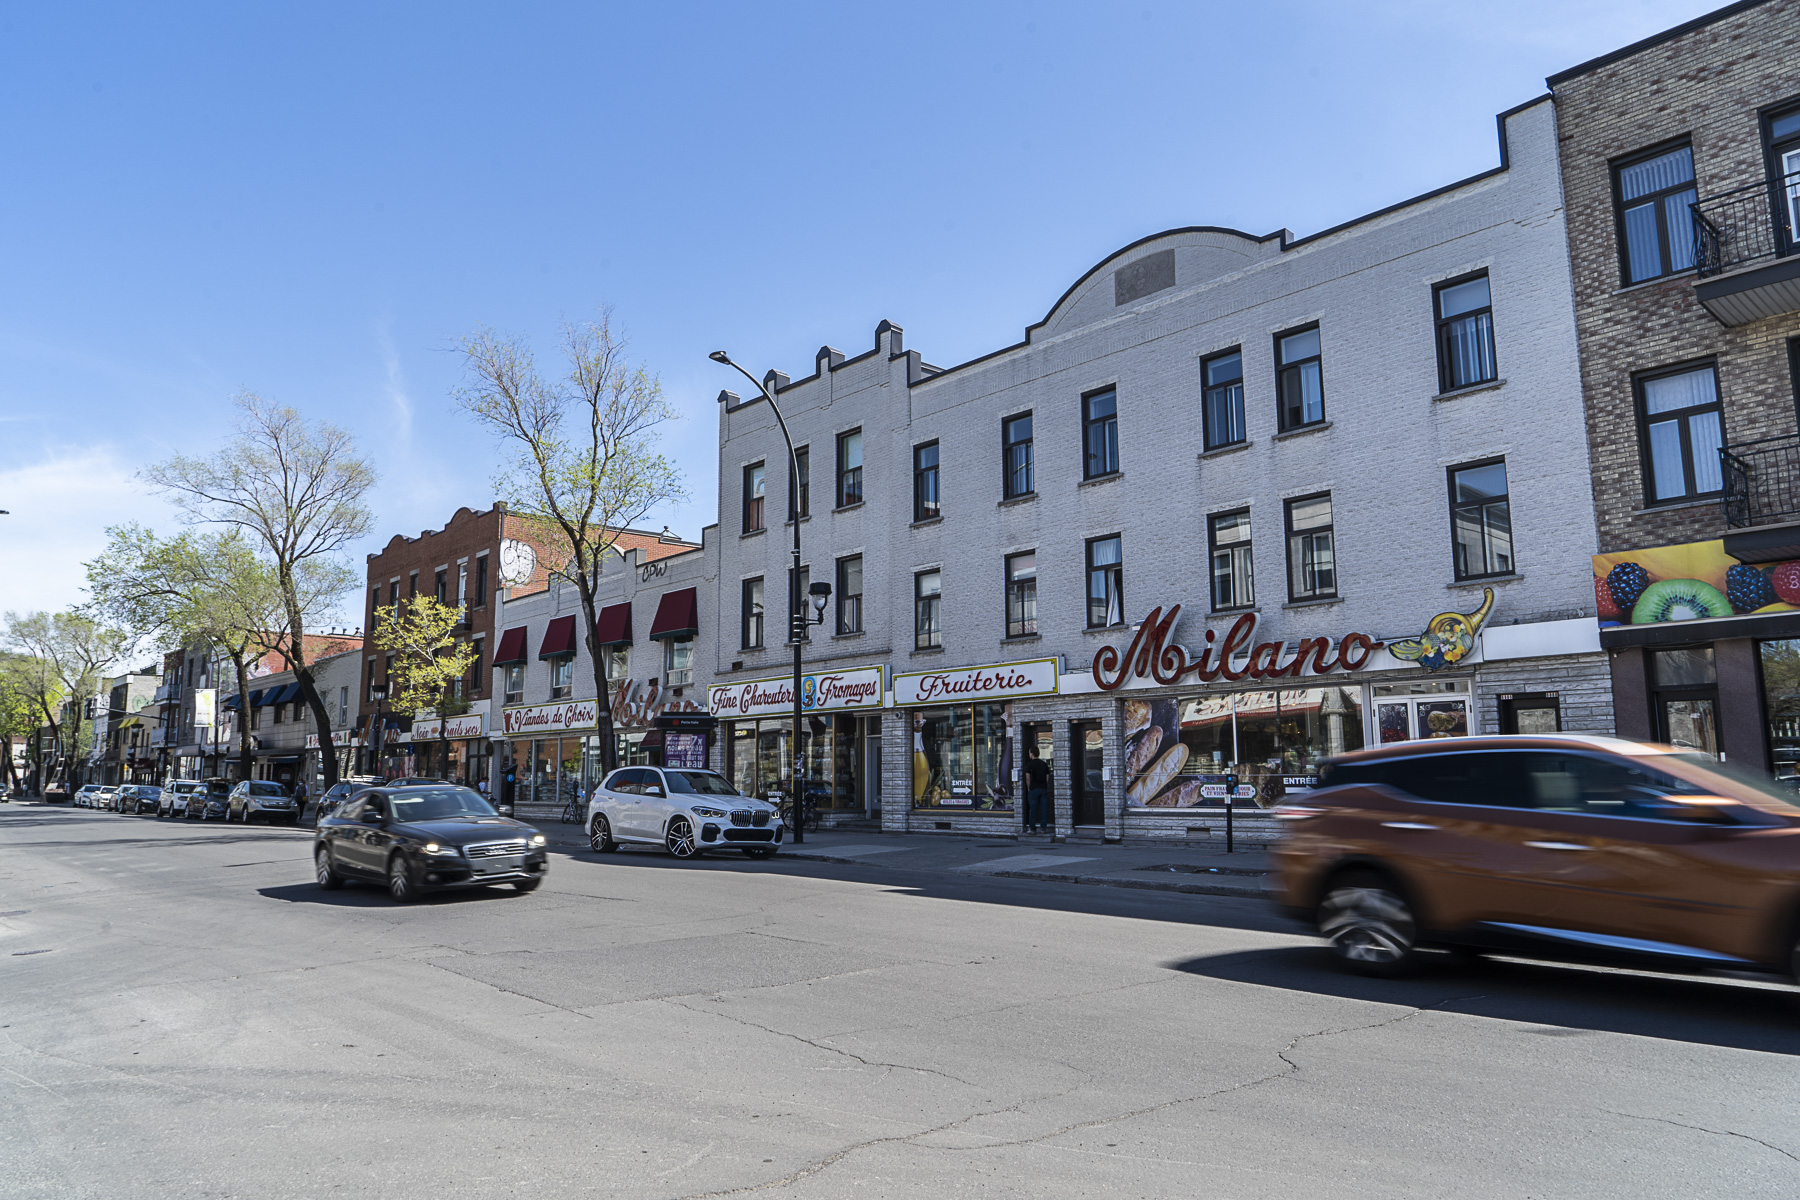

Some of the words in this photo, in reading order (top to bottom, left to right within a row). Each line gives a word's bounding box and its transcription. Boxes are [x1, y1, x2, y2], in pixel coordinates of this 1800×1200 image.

[1092, 604, 1388, 691] Milano
[711, 686, 737, 715] Fine
[739, 683, 795, 714] Charcuteri
[817, 675, 877, 706] Fromages
[916, 669, 1032, 701] Fruiterie
[514, 708, 550, 732] Viandes
[551, 707, 563, 724] de
[564, 703, 594, 728] Choix
[1283, 776, 1318, 785] ENTRÉE
